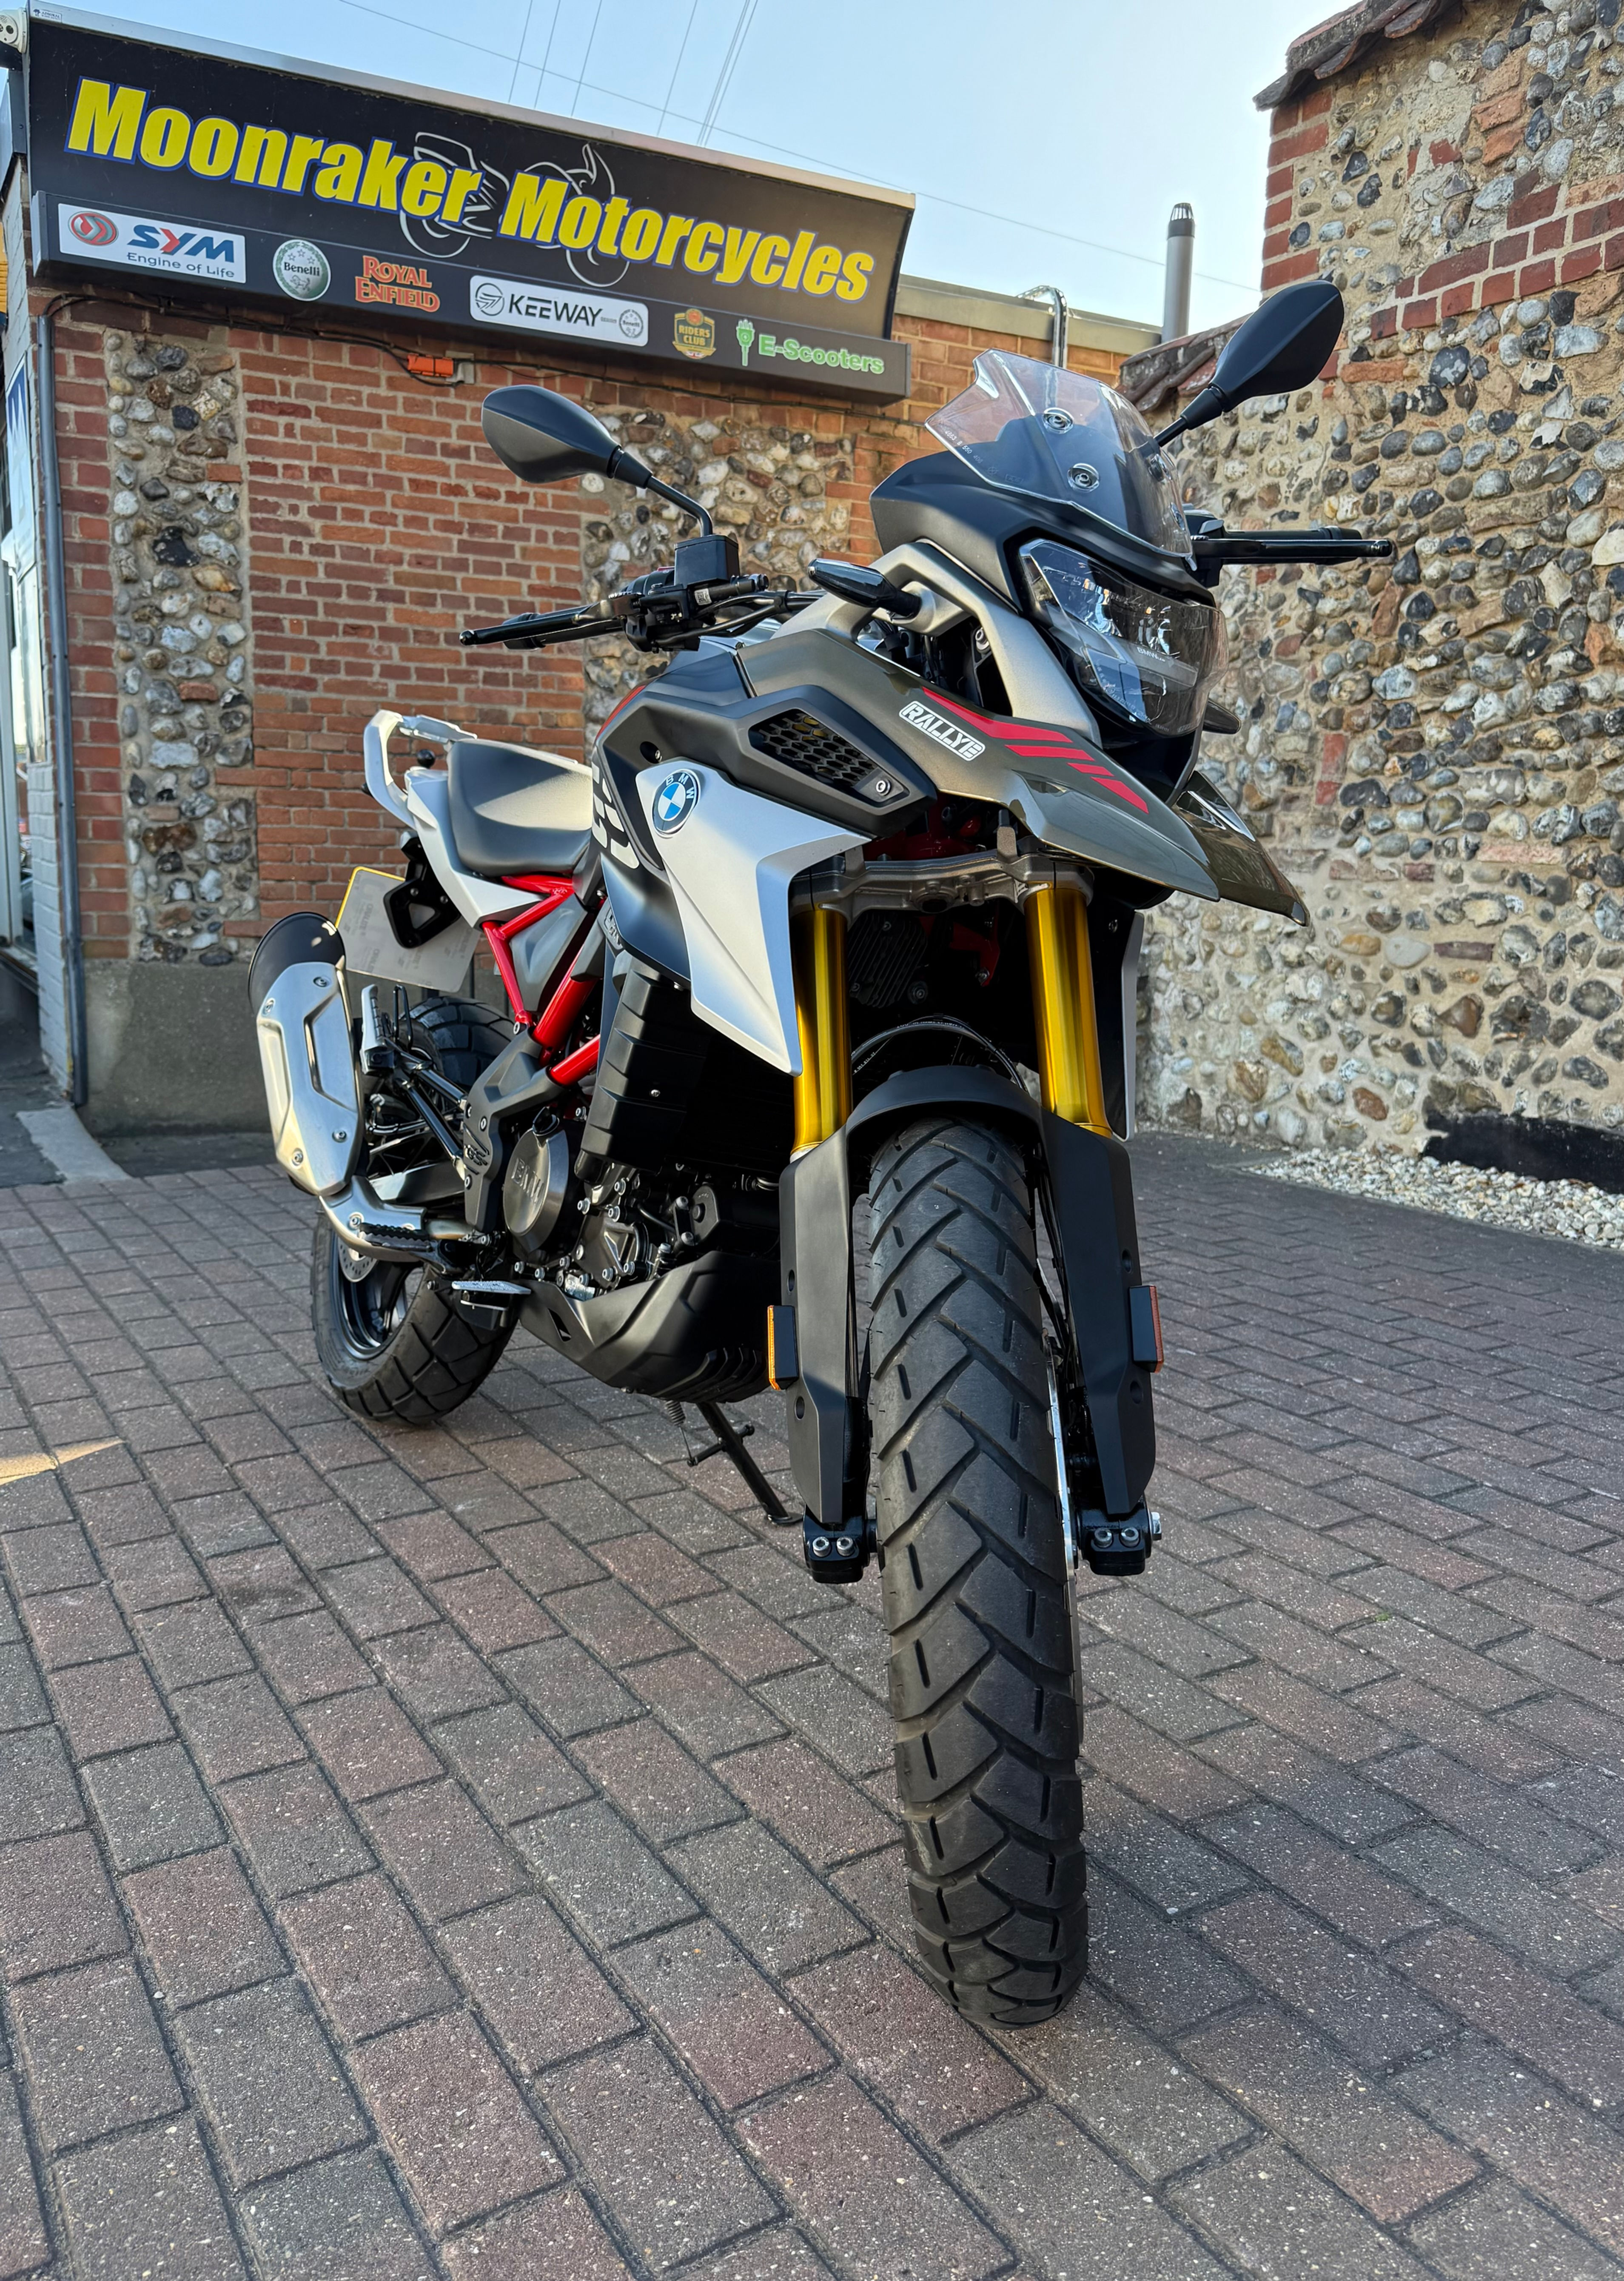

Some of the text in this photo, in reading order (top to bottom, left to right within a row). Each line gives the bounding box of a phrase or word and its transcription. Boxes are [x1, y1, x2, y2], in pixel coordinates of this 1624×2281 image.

[64, 76, 875, 305] Moonraker Motorcycles
[126, 225, 234, 263] SYM
[128, 252, 235, 278] Engine of Life
[284, 262, 321, 277] Benelli
[362, 255, 432, 288] ROYAL
[354, 276, 441, 313] ENFIELD
[509, 294, 603, 327] KEEWAY
[678, 325, 710, 338] RIDERS
[683, 335, 705, 346] CLUB
[758, 334, 885, 374] E-Scooters
[1137, 647, 1158, 659] BMW
[900, 703, 983, 759] RALLYE
[665, 773, 695, 799] BMW
